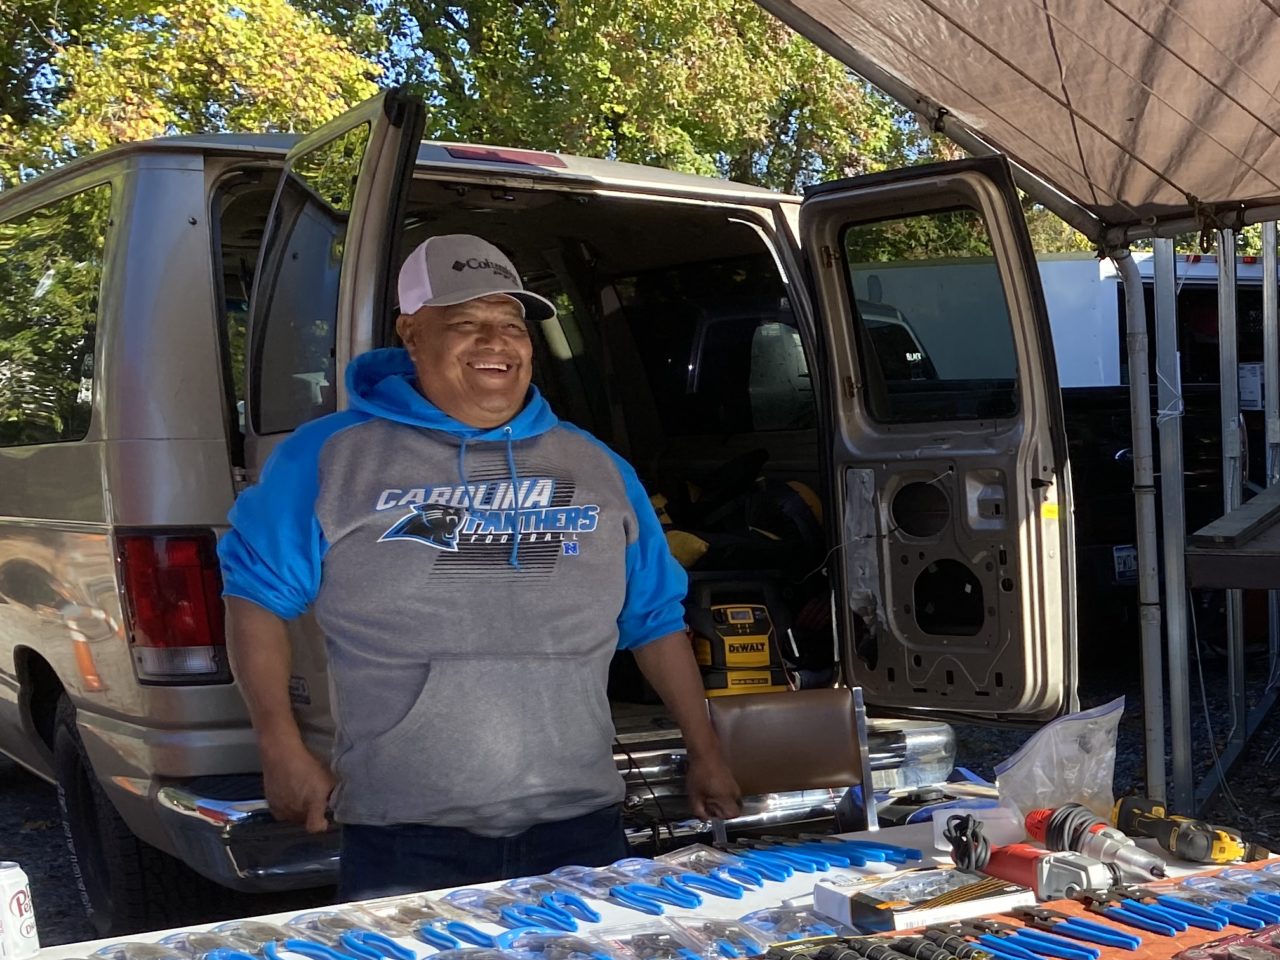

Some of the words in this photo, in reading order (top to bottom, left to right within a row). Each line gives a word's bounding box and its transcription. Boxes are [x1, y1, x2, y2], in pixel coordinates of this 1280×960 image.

[376, 480, 553, 511] CAROLINA
[463, 505, 600, 534] PANTHERS
[470, 533, 579, 543] FOOTBALL
[728, 642, 766, 653] DEWALT
